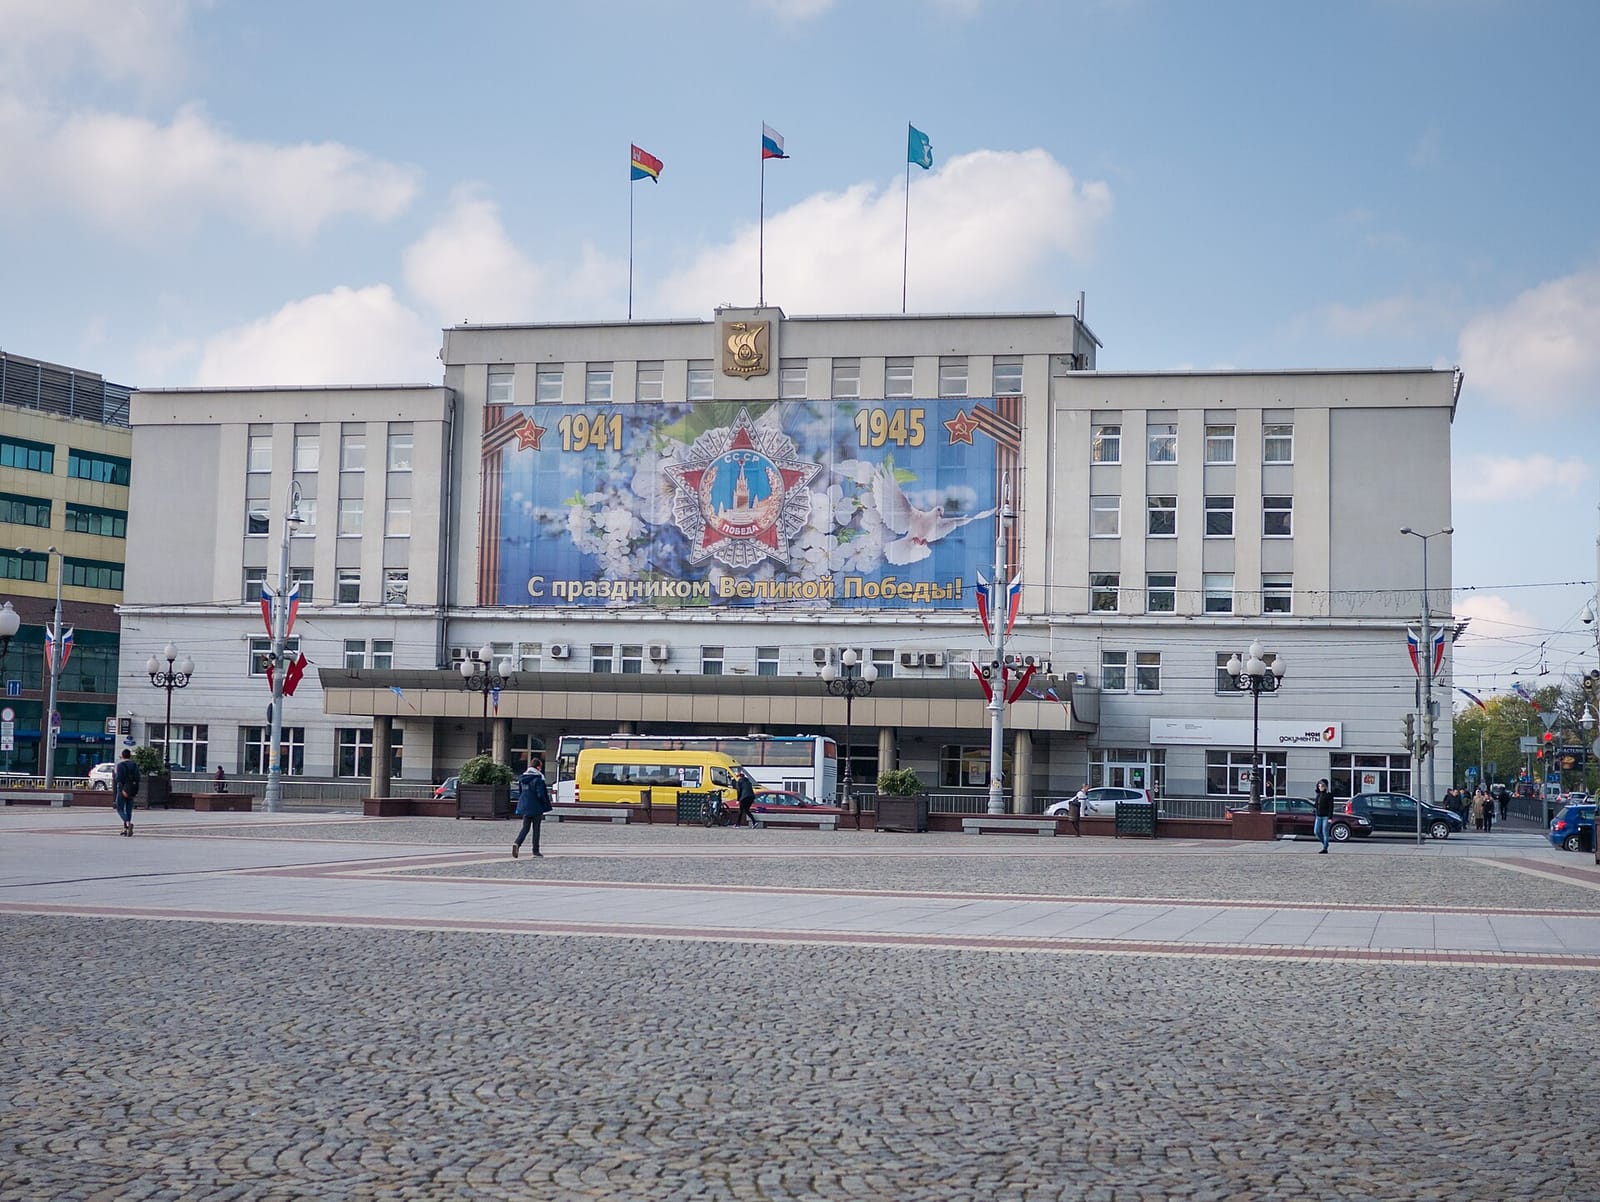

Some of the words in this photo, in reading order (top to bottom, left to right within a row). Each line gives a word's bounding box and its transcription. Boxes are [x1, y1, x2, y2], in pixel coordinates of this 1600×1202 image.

[558, 414, 623, 452] 1941
[854, 408, 926, 448] 1945
[724, 452, 760, 464] СССР
[722, 523, 760, 535] ПОБЕДА
[527, 576, 545, 598] С
[551, 580, 711, 602] праздником
[719, 575, 834, 599] Великой
[844, 576, 963, 603] Победы!
